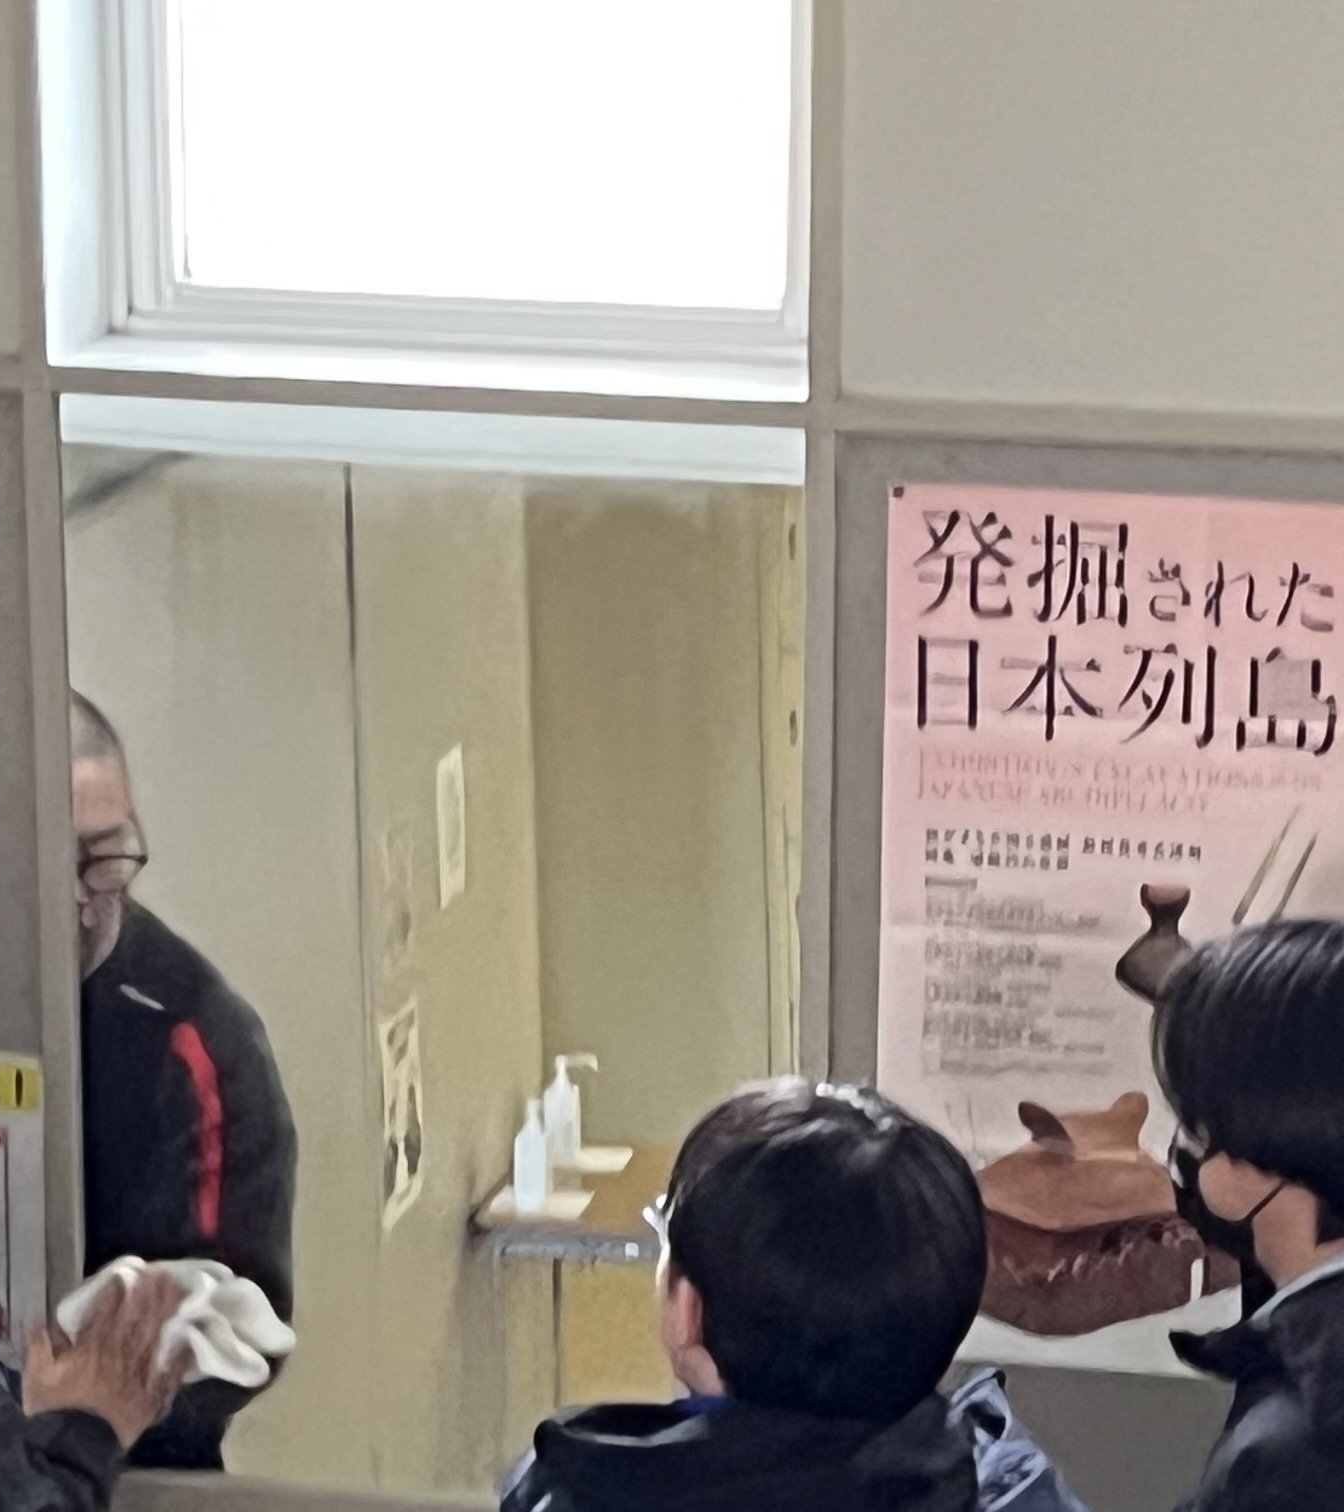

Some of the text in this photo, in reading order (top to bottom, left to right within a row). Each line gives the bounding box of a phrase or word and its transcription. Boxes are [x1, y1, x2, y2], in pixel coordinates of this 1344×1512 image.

[913, 509, 1334, 631] 発掘された
[916, 634, 1338, 755] 日本列島
